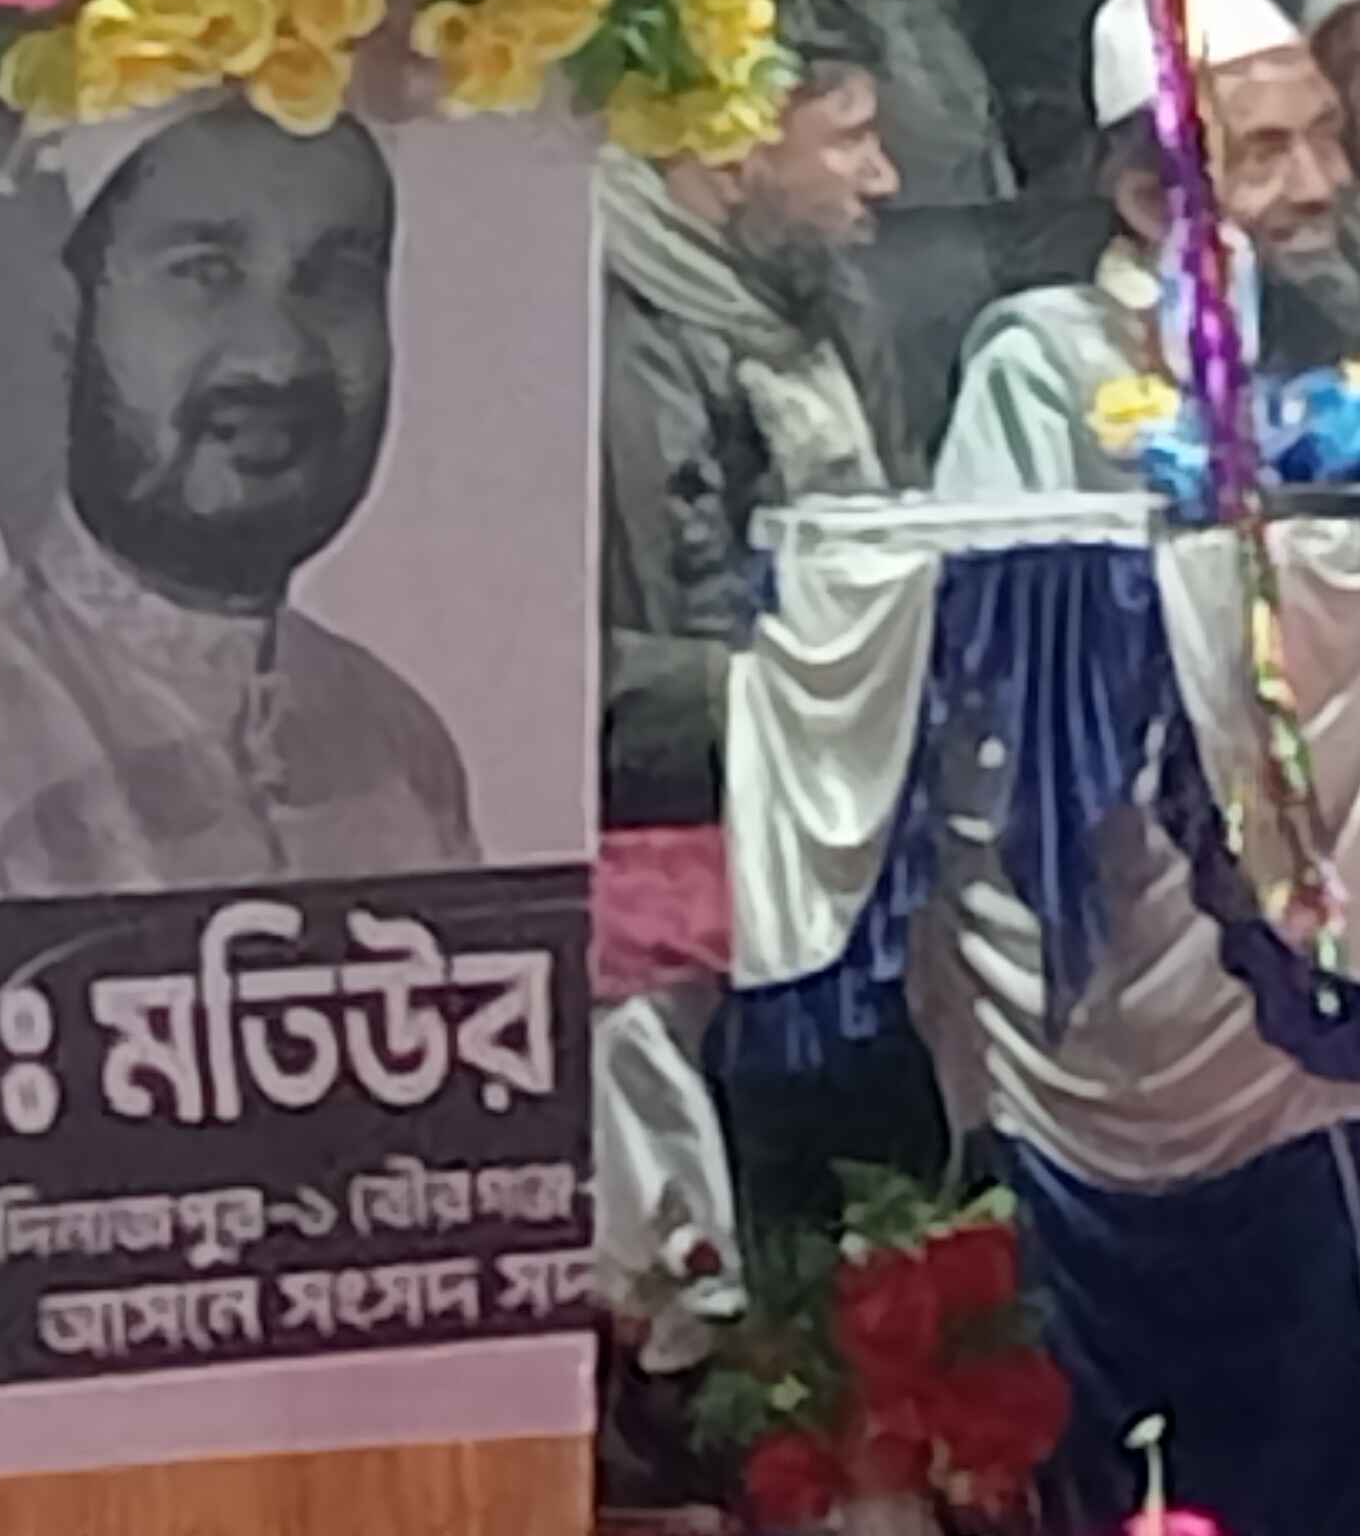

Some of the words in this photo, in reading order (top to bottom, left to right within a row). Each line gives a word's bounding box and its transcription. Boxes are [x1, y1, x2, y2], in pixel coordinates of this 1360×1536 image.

[89, 900, 557, 1127] মতিউর
[40, 1275, 263, 1358] আসনে
[276, 1257, 480, 1339] সংসদ
